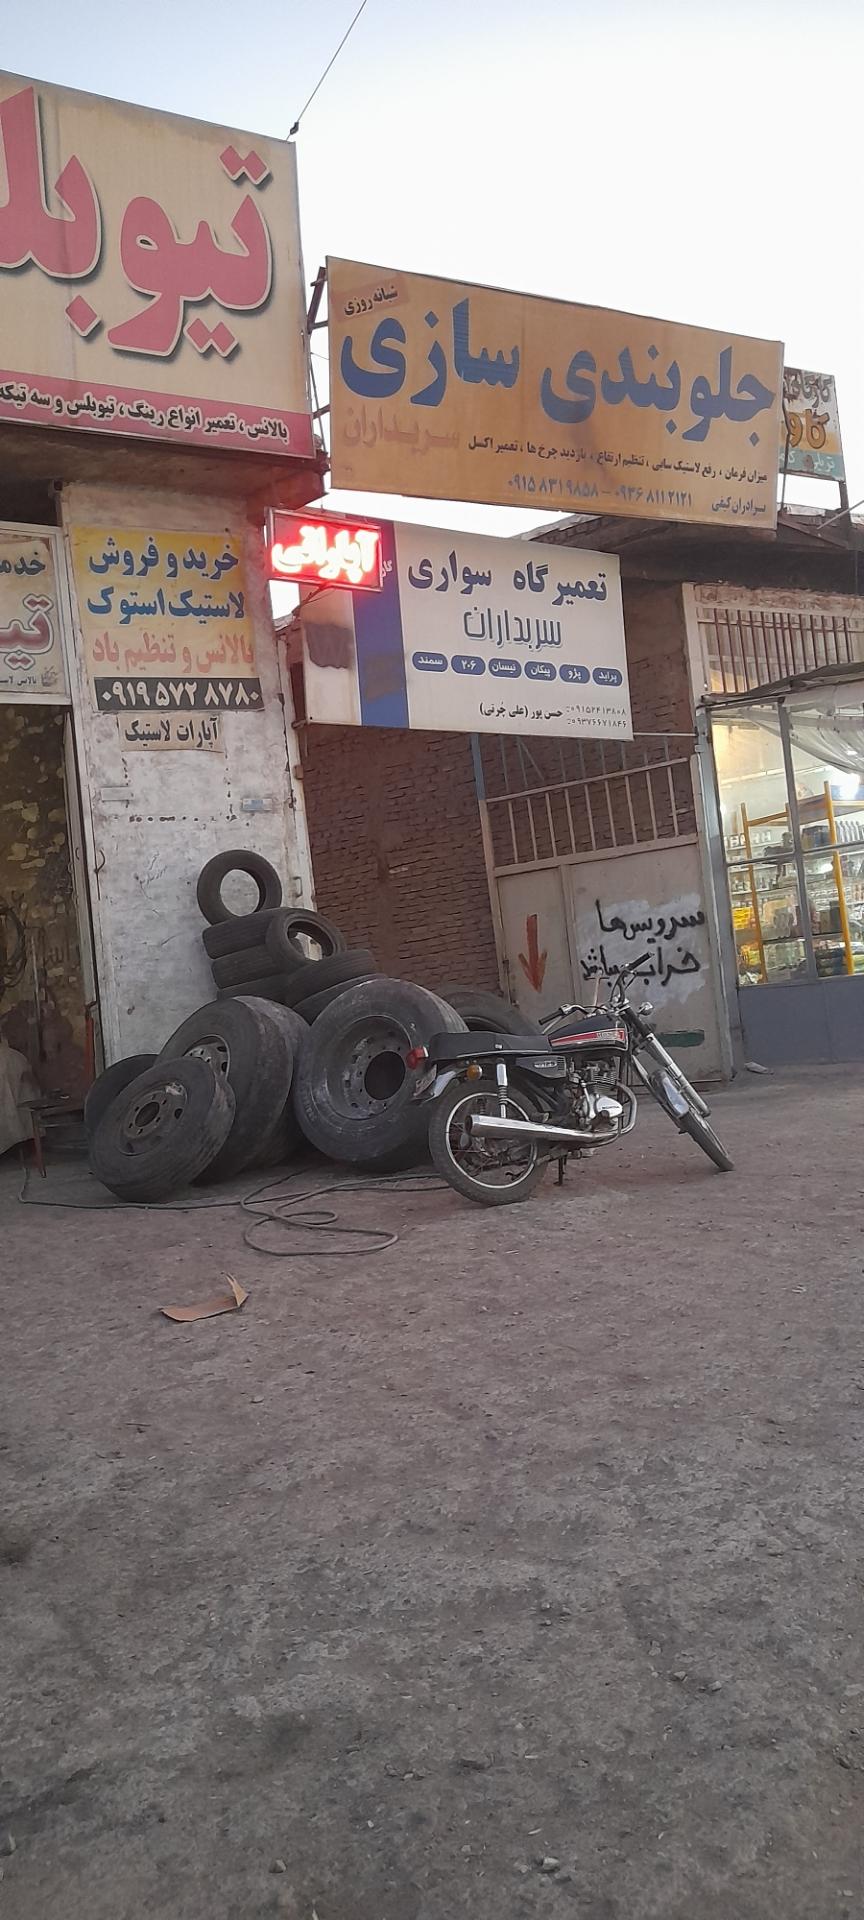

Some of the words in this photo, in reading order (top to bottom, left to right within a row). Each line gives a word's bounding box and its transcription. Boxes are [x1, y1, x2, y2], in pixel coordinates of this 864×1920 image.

[0, 86, 272, 357] تیوبل
[343, 297, 374, 316] روزی
[340, 297, 520, 407] سازی
[30, 389, 51, 406] سه
[54, 397, 63, 413] و
[66, 394, 116, 418] تیوبلس
[167, 407, 201, 430] انواع
[204, 415, 236, 433] تعمیر
[468, 435, 494, 451] اکسل
[89, 537, 159, 577] فروش
[166, 550, 179, 578] و
[182, 544, 239, 580] خرید
[408, 550, 493, 595] سواری
[87, 585, 166, 625] استوک
[167, 589, 246, 624] لاستیک
[463, 606, 563, 650] سربداران
[92, 631, 120, 670] باد
[124, 631, 177, 673] تنظیم
[182, 644, 193, 675] و
[196, 632, 255, 675] بالانس
[417, 654, 444, 666] سمند
[461, 660, 477, 671] ۲۰۶
[491, 661, 517, 675] نیسان
[530, 664, 551, 678] پیکان
[567, 667, 582, 681] پژو
[598, 670, 618, 684] پراید
[102, 680, 151, 707] ۰۹۱۹
[155, 680, 198, 707] ۵۷۲
[204, 680, 261, 707] ۸۷۸۰
[124, 718, 171, 747] لاستیک
[176, 716, 220, 749] آپارات
[636, 947, 700, 986] خراب
